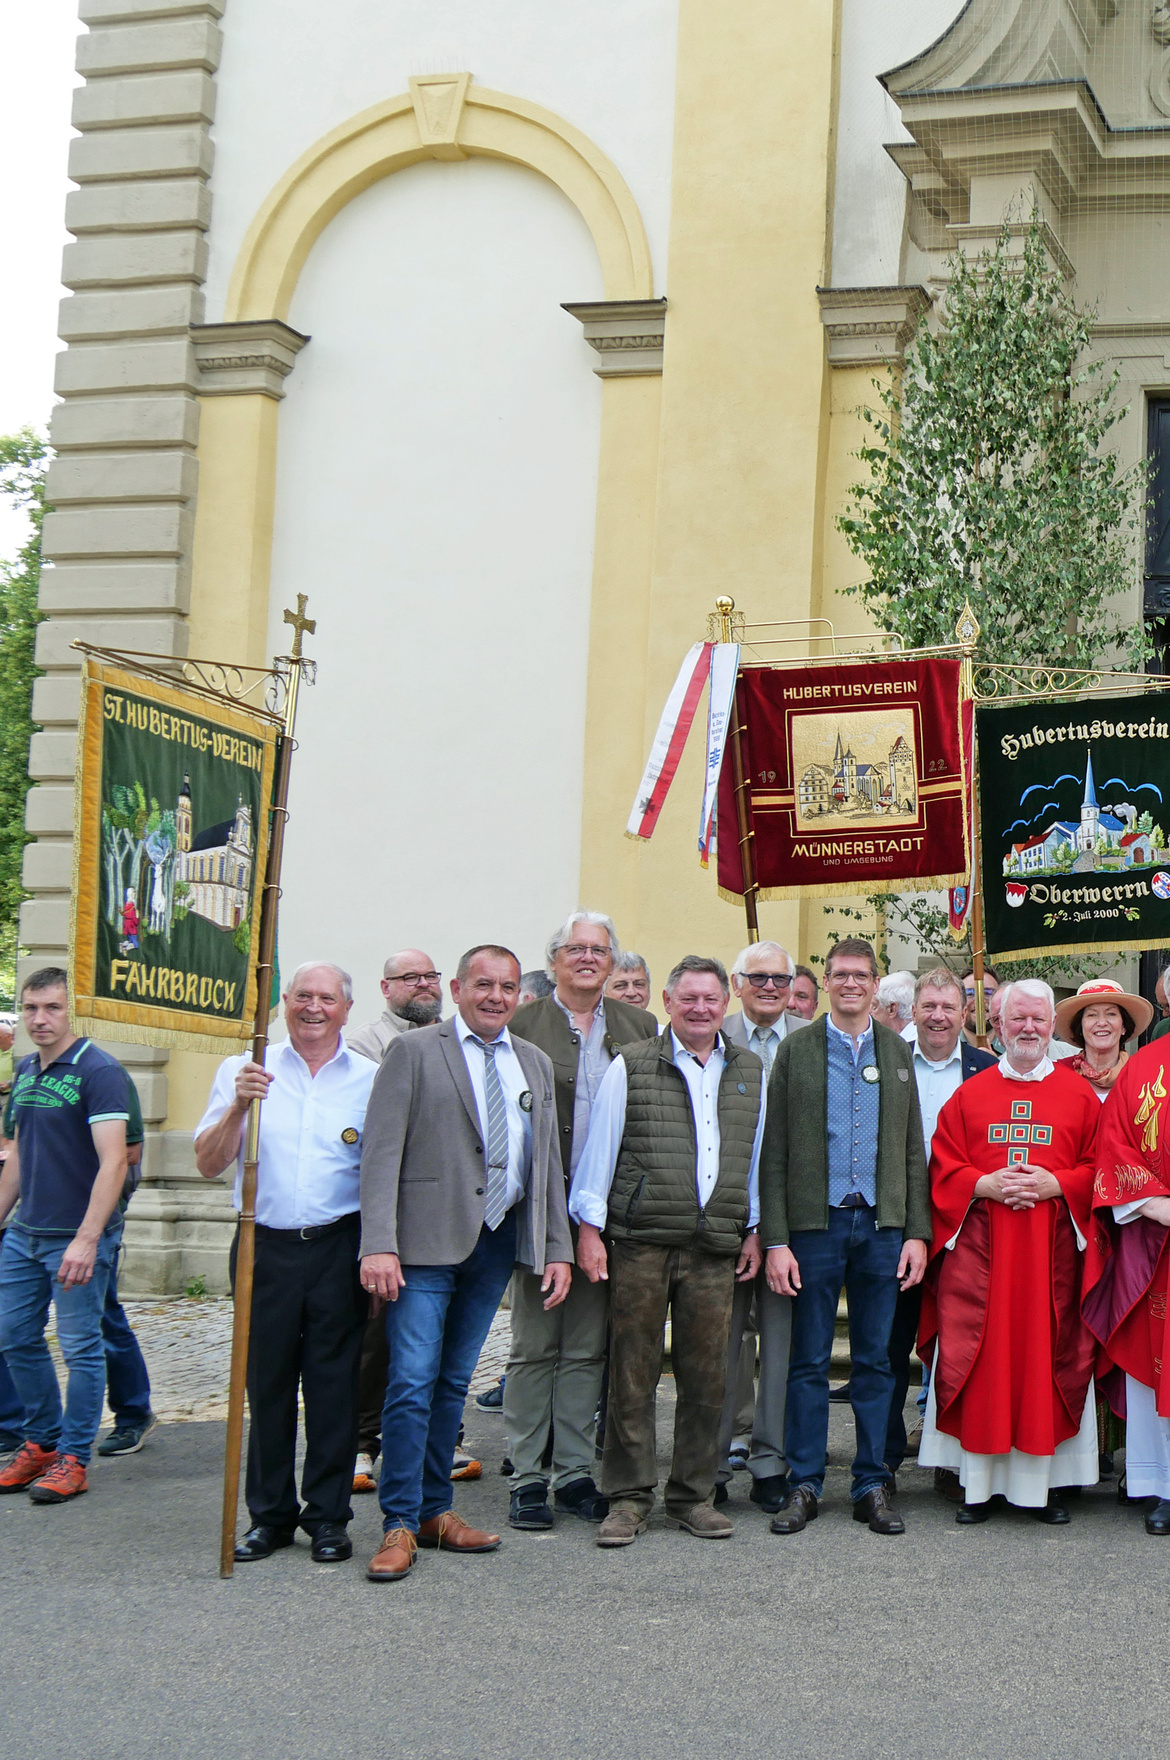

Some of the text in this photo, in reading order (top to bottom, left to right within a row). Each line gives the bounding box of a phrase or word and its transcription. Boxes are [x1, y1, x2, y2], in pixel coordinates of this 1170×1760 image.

[783, 680, 918, 700] HUBERTUSVEREIN
[1000, 716, 1170, 761] Hubertusverein
[928, 758, 948, 772] 22
[757, 770, 777, 784] 19
[791, 837, 925, 858] MÜNNERSTADT
[822, 855, 894, 866] UND UMGEBUNG
[1029, 880, 1151, 905] Oberwerrn
[1061, 908, 1120, 923] 2. Juli 2000
[40, 1075, 82, 1106] LEAGUE
